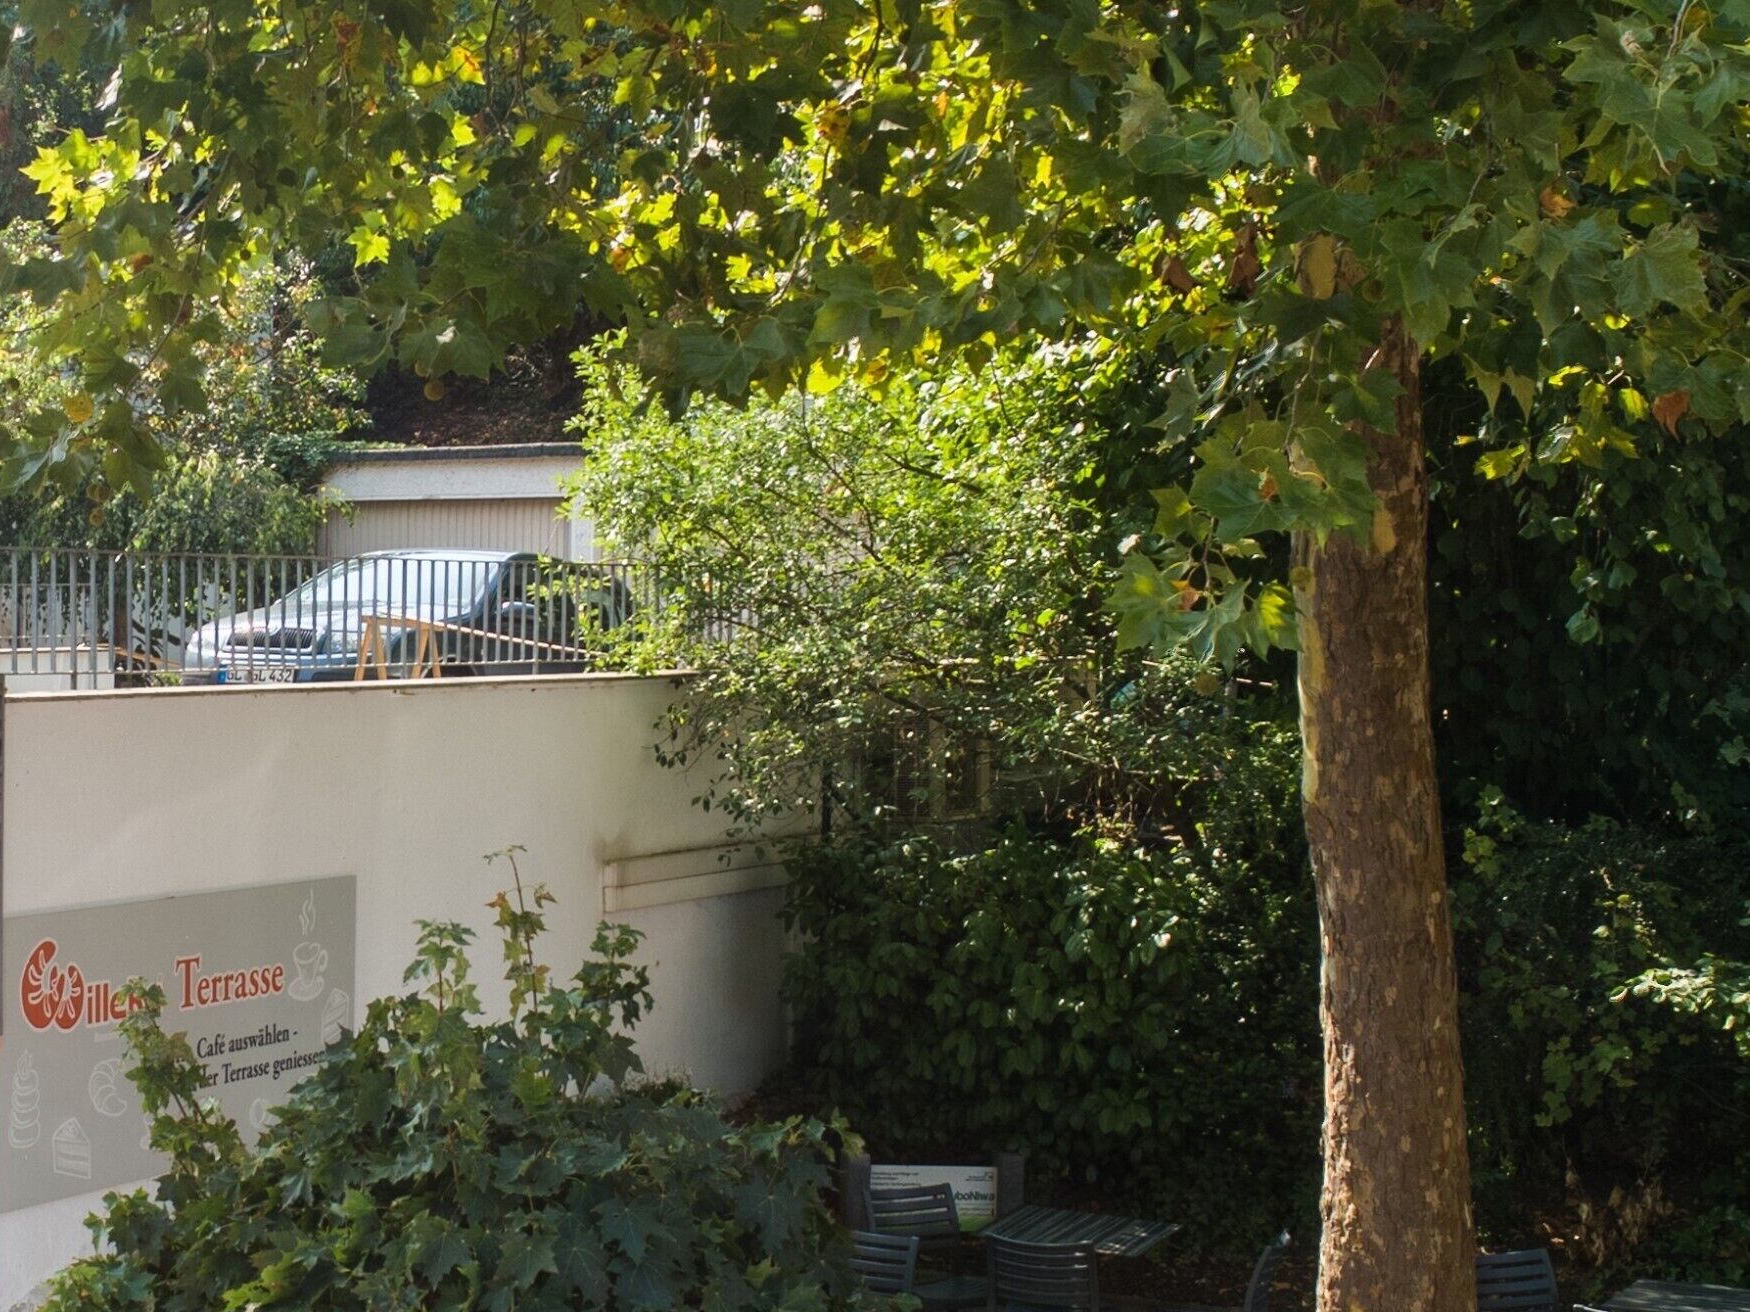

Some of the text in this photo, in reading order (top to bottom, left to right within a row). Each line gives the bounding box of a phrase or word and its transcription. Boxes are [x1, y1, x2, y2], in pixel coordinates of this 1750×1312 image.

[21, 940, 285, 1030] Wille Terrasse
[197, 1033, 225, 1058] Café
[228, 1023, 290, 1053] auswählen
[222, 1062, 270, 1085] Terrasse
